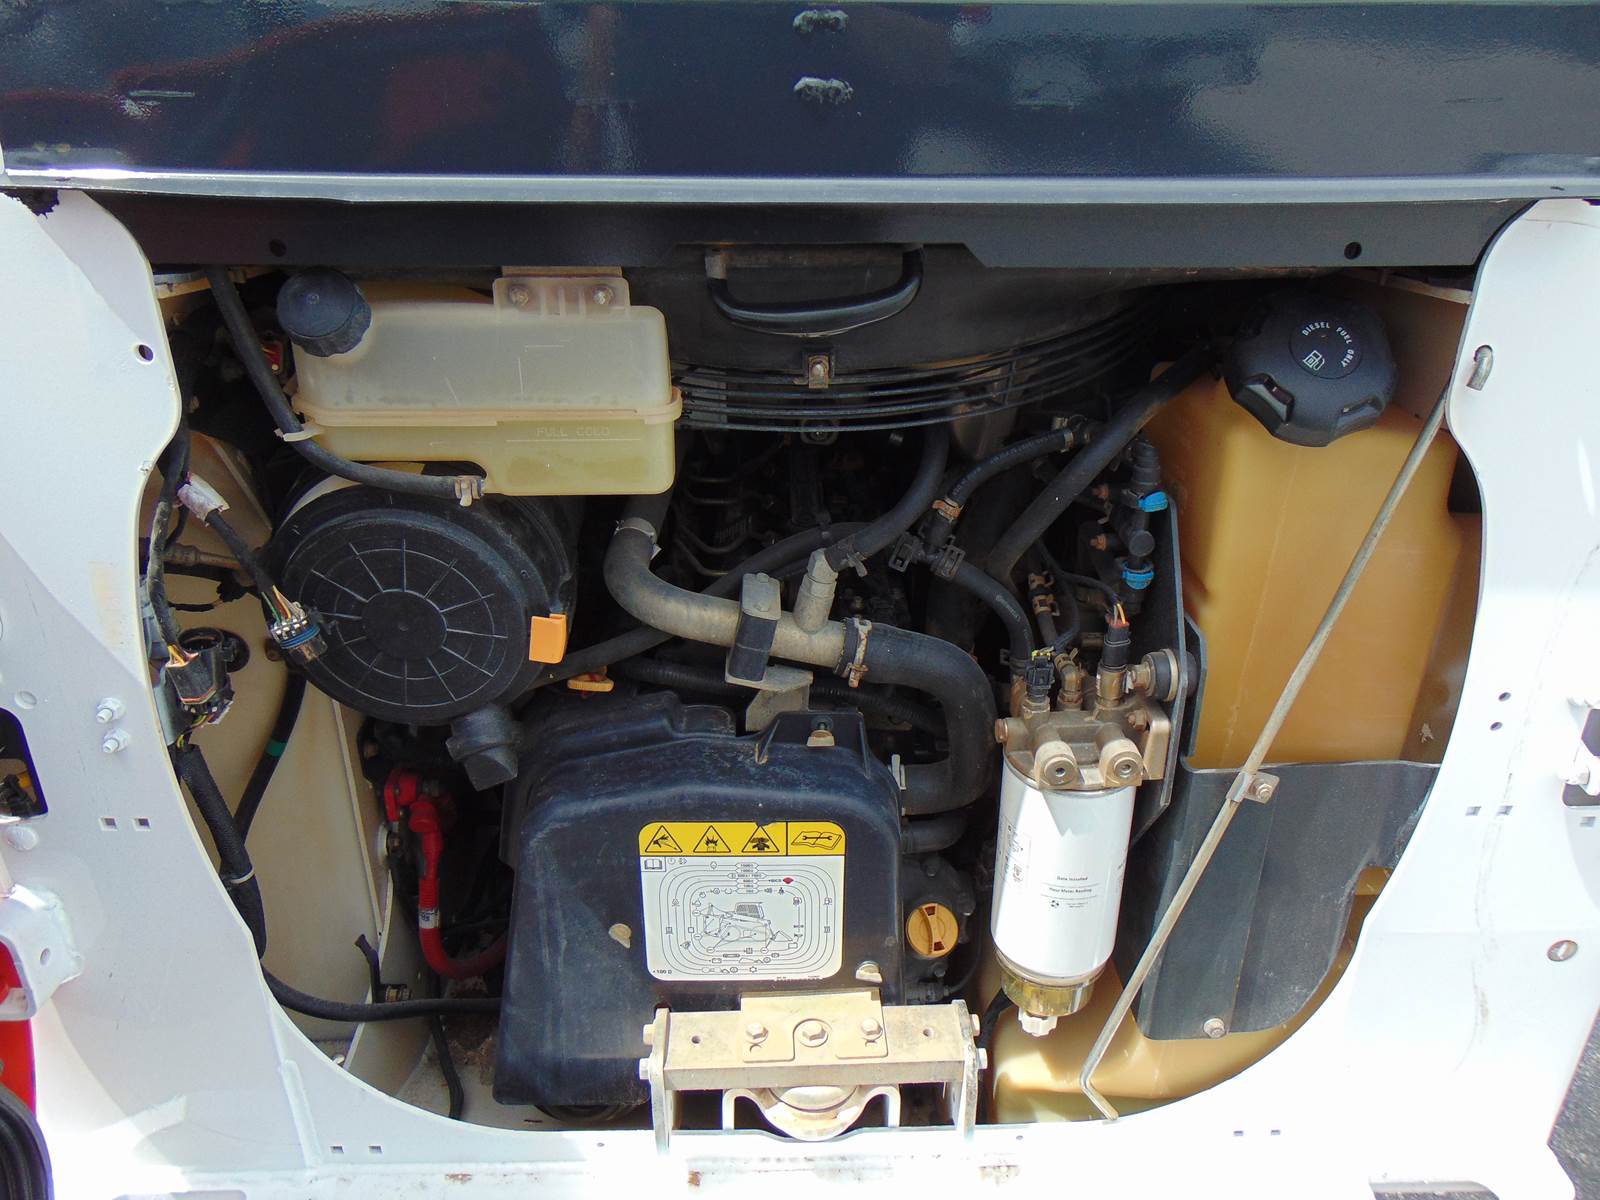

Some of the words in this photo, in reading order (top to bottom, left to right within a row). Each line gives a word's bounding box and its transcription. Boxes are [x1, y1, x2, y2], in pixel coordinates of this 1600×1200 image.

[1302, 322, 1330, 335] DIESEL
[1336, 327, 1352, 344] FUEL
[1341, 349, 1354, 367] ONLY
[536, 426, 568, 438] FULL
[575, 425, 609, 437] COLD
